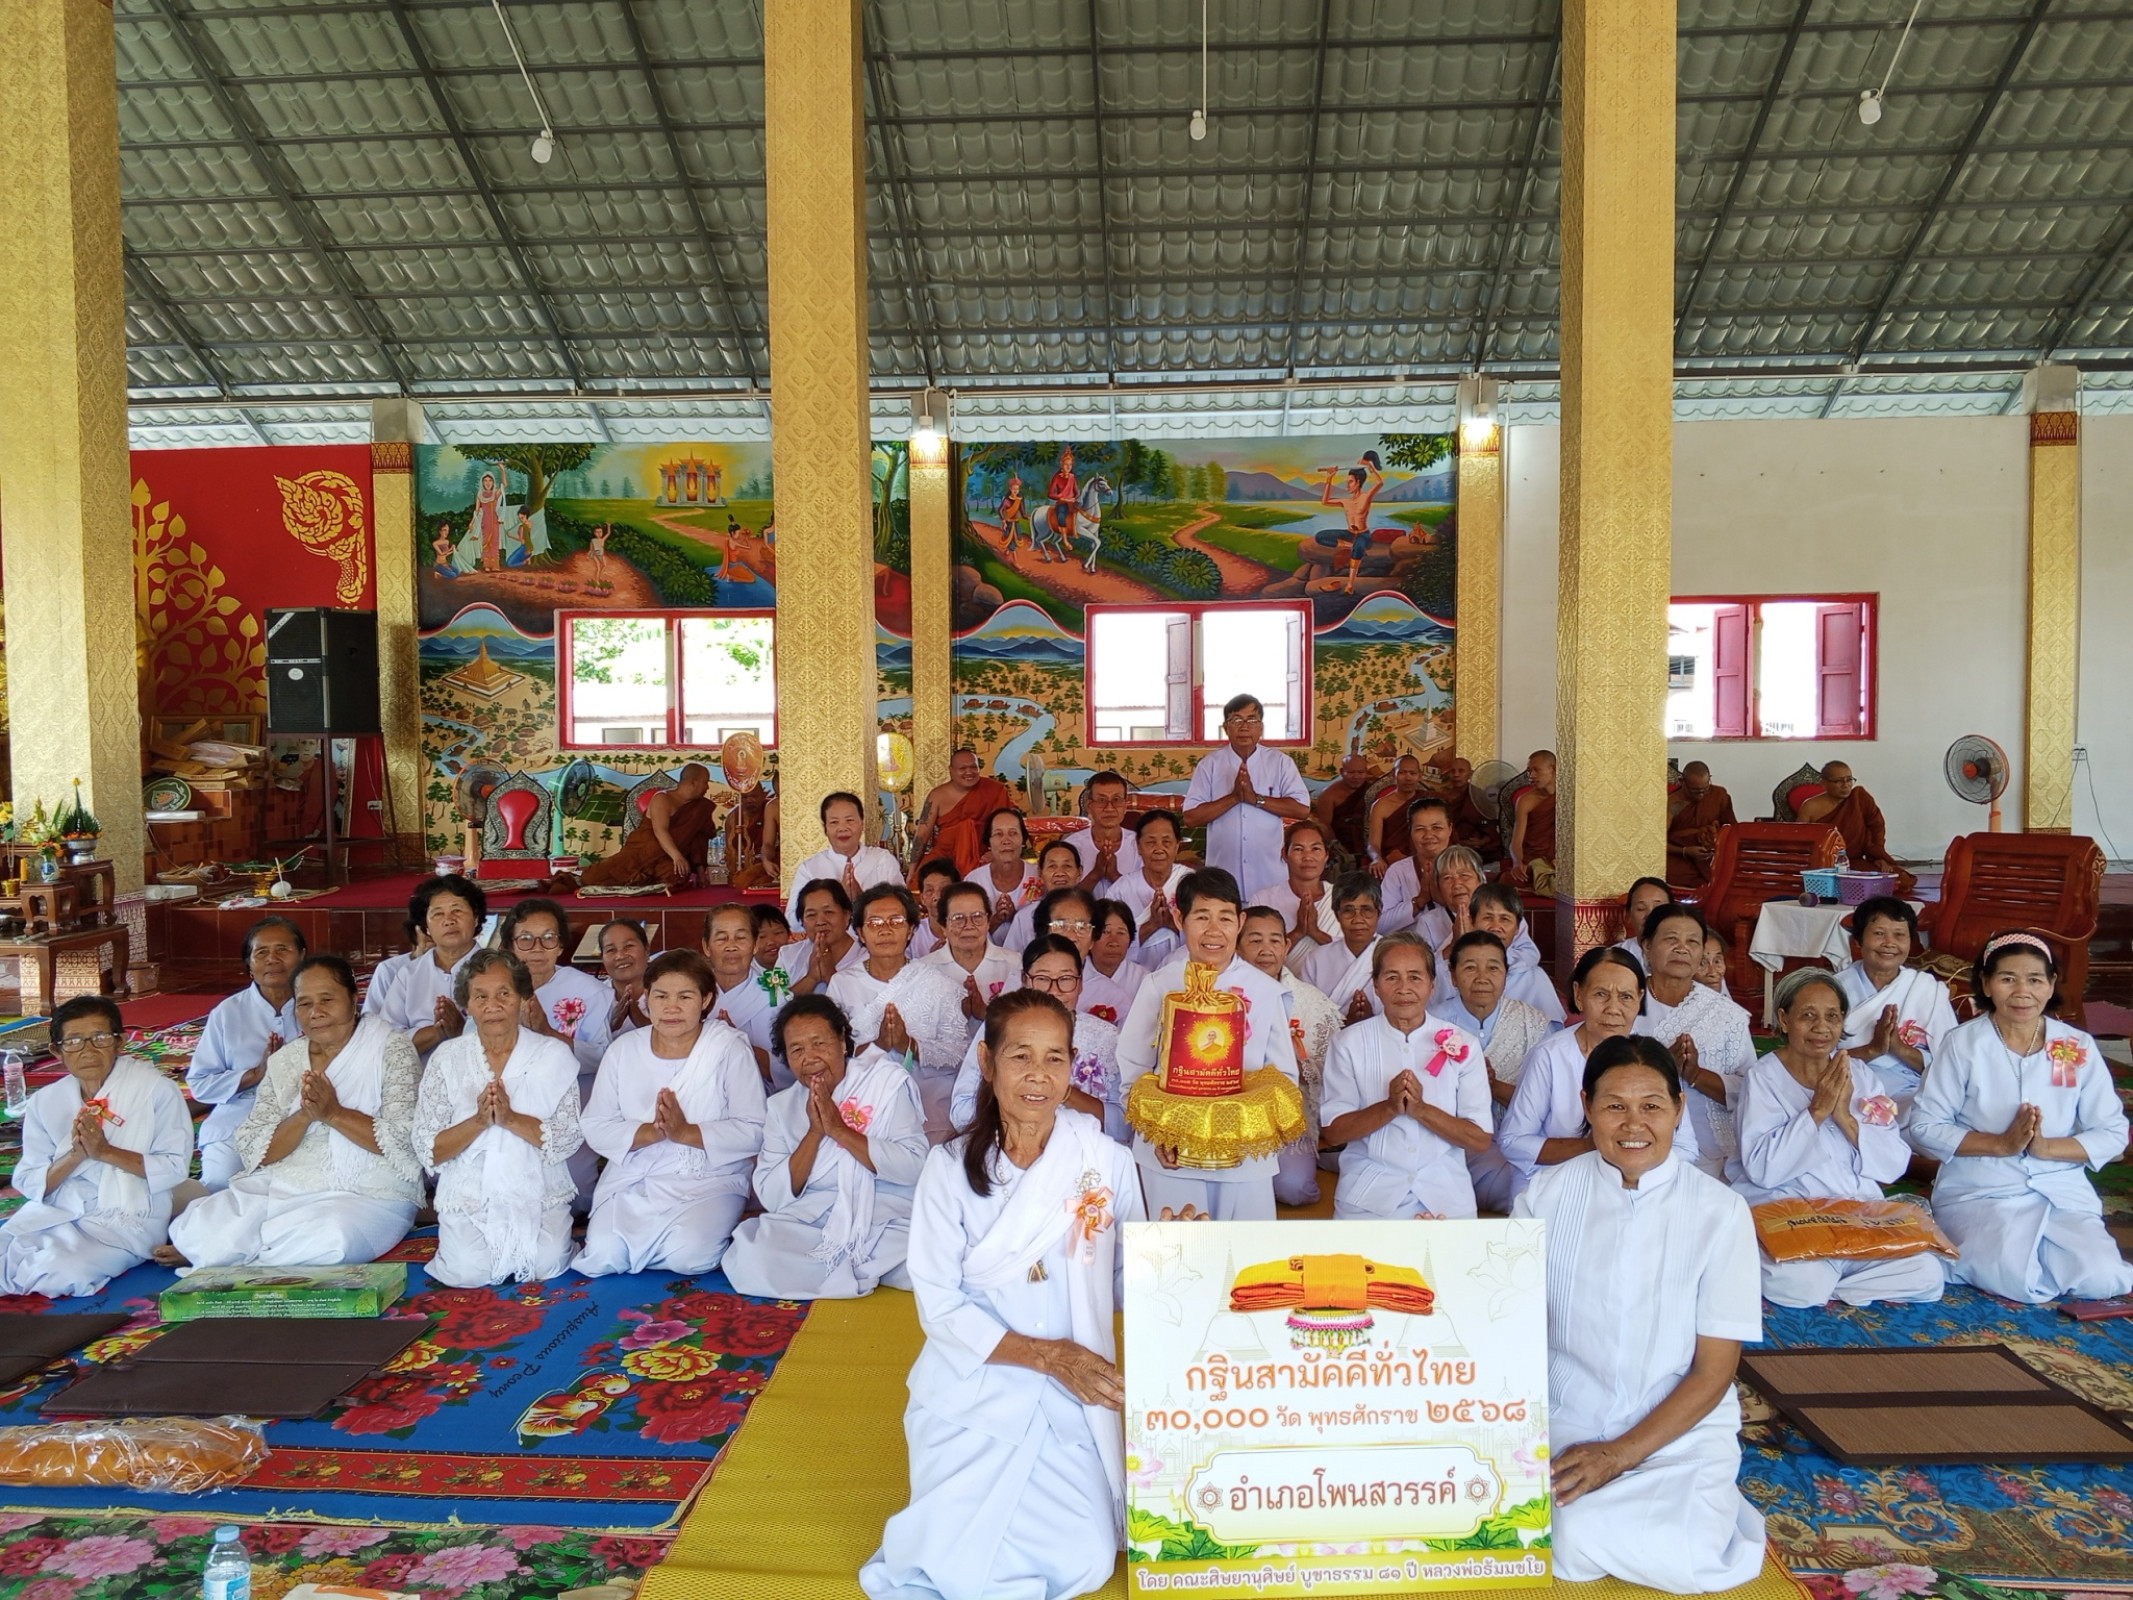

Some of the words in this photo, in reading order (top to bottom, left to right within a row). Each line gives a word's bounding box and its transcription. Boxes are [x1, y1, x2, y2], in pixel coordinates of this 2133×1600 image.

[535, 1301, 599, 1360] Auspicious
[488, 1362, 542, 1398] Peony
[1185, 1341, 1476, 1401] กฐินสามัคคีทั่วไทย
[1145, 1406, 1270, 1434] ๓๐,๐๐๐
[1276, 1405, 1303, 1428] วัด
[1307, 1404, 1419, 1434] พุทธศักราช
[1425, 1397, 1527, 1425] ๒๕๖๘
[1229, 1466, 1456, 1512] อำเภอโพนสวรรค์
[1138, 1570, 1168, 1589] โดย
[1173, 1564, 1296, 1590] คณะศิษยานุศิษย์
[1300, 1567, 1374, 1588] บูชาธรรม
[1378, 1567, 1402, 1580] ๘๑
[1406, 1561, 1418, 1579] ปี
